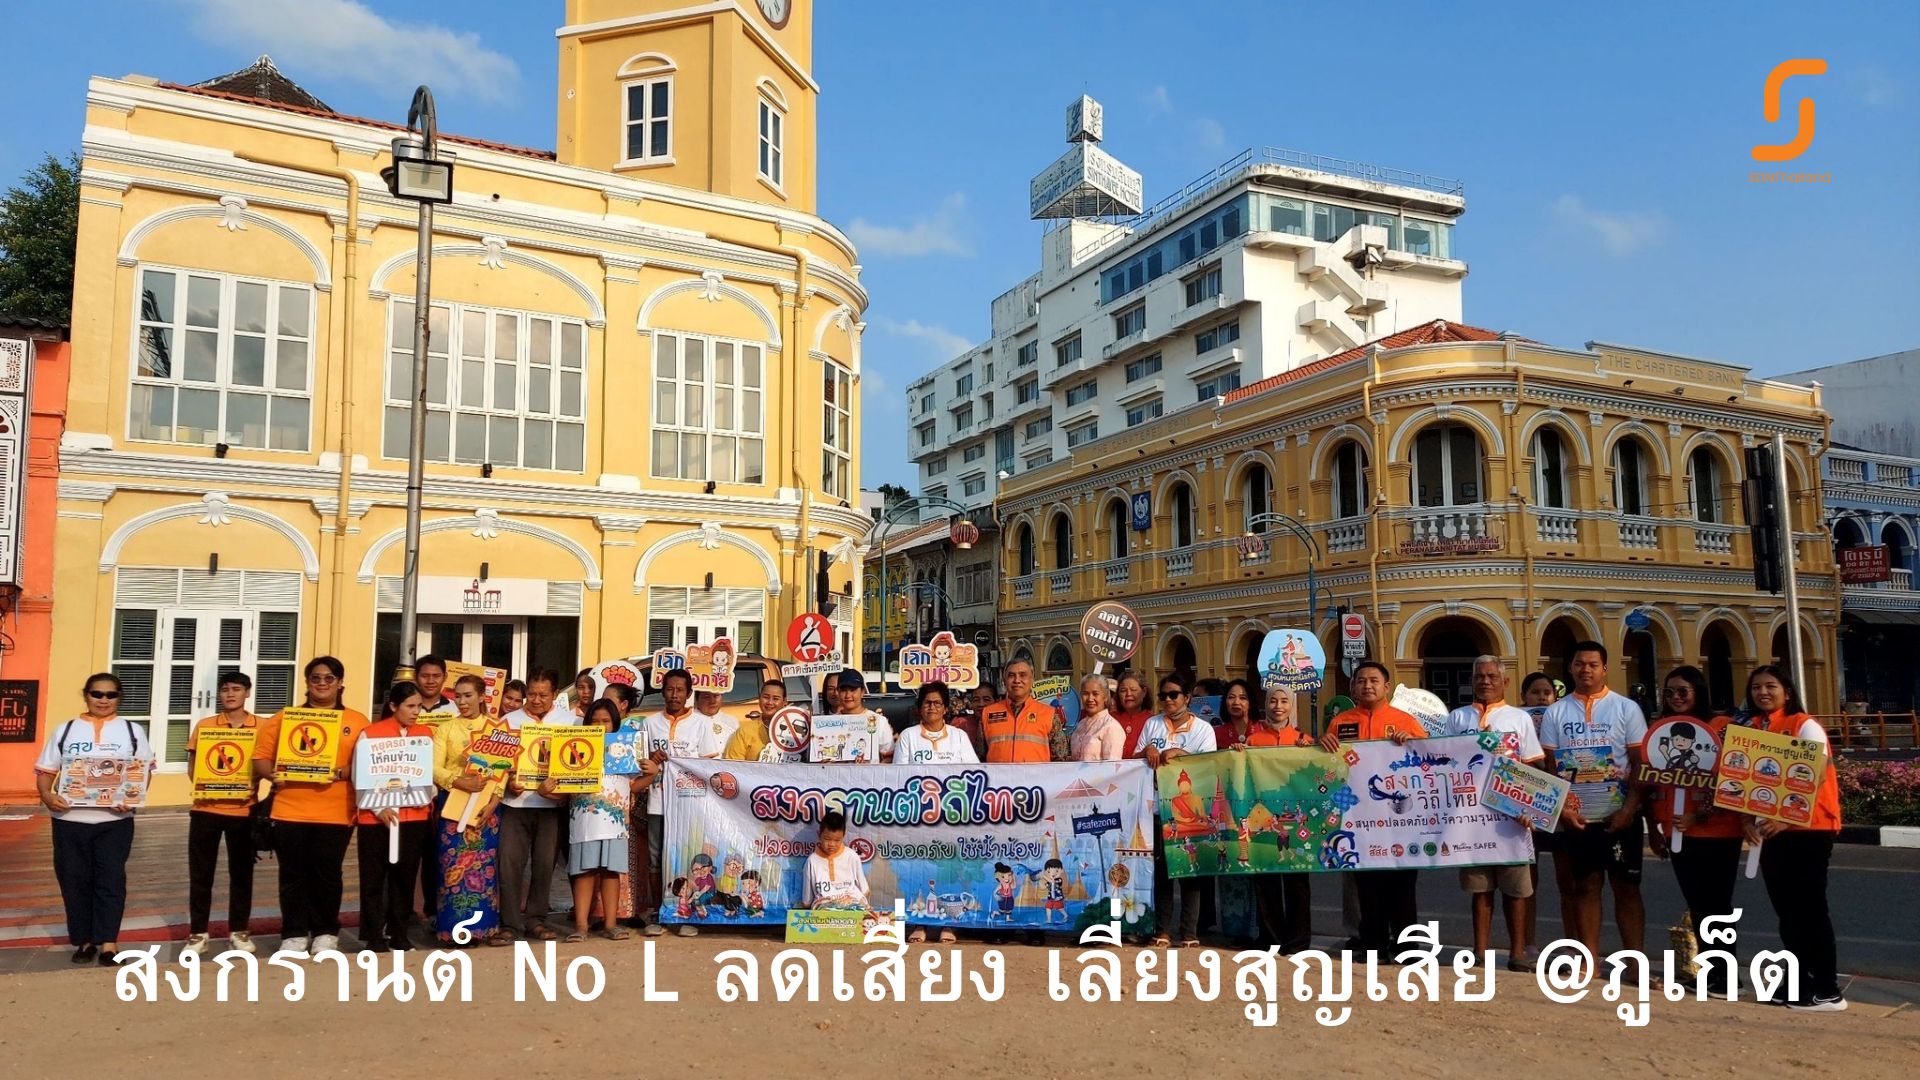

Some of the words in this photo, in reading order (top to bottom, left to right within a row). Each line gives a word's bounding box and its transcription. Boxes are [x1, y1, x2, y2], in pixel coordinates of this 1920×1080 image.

[1121, 188, 1140, 210] HOTEL
[1608, 354, 1631, 369] THE
[1635, 360, 1704, 380] CHARTERED
[1708, 370, 1737, 385] BANK
[1098, 610, 1133, 630] ลดเร็ว
[1086, 626, 1133, 650] ลดเสี่ยง
[657, 652, 684, 669] เลิก
[904, 650, 931, 665] เลิก
[1562, 720, 1585, 739] สุข
[68, 741, 93, 756] สุข
[370, 739, 406, 753] หยุดรถ
[472, 735, 517, 759] ย้อนศร
[653, 738, 669, 751] สข
[1151, 736, 1167, 749] สข
[370, 750, 417, 765] ให้คนข้าม
[914, 749, 933, 764] สุข
[370, 762, 423, 776] ทางม้าลาย
[752, 772, 1044, 824] สงกรานต์วิถีไทย
[1493, 776, 1534, 805] ไม่ดื่ม
[1076, 817, 1118, 830] #safezone
[1355, 819, 1377, 832] สนุก
[1385, 815, 1429, 828] ปลอดภัย
[1435, 813, 1509, 827] ไร้ความรุนแร
[878, 838, 953, 859] ปลอดภัย
[957, 833, 1043, 857] ใช้น้ำน้อย
[1473, 842, 1498, 850] SAFER
